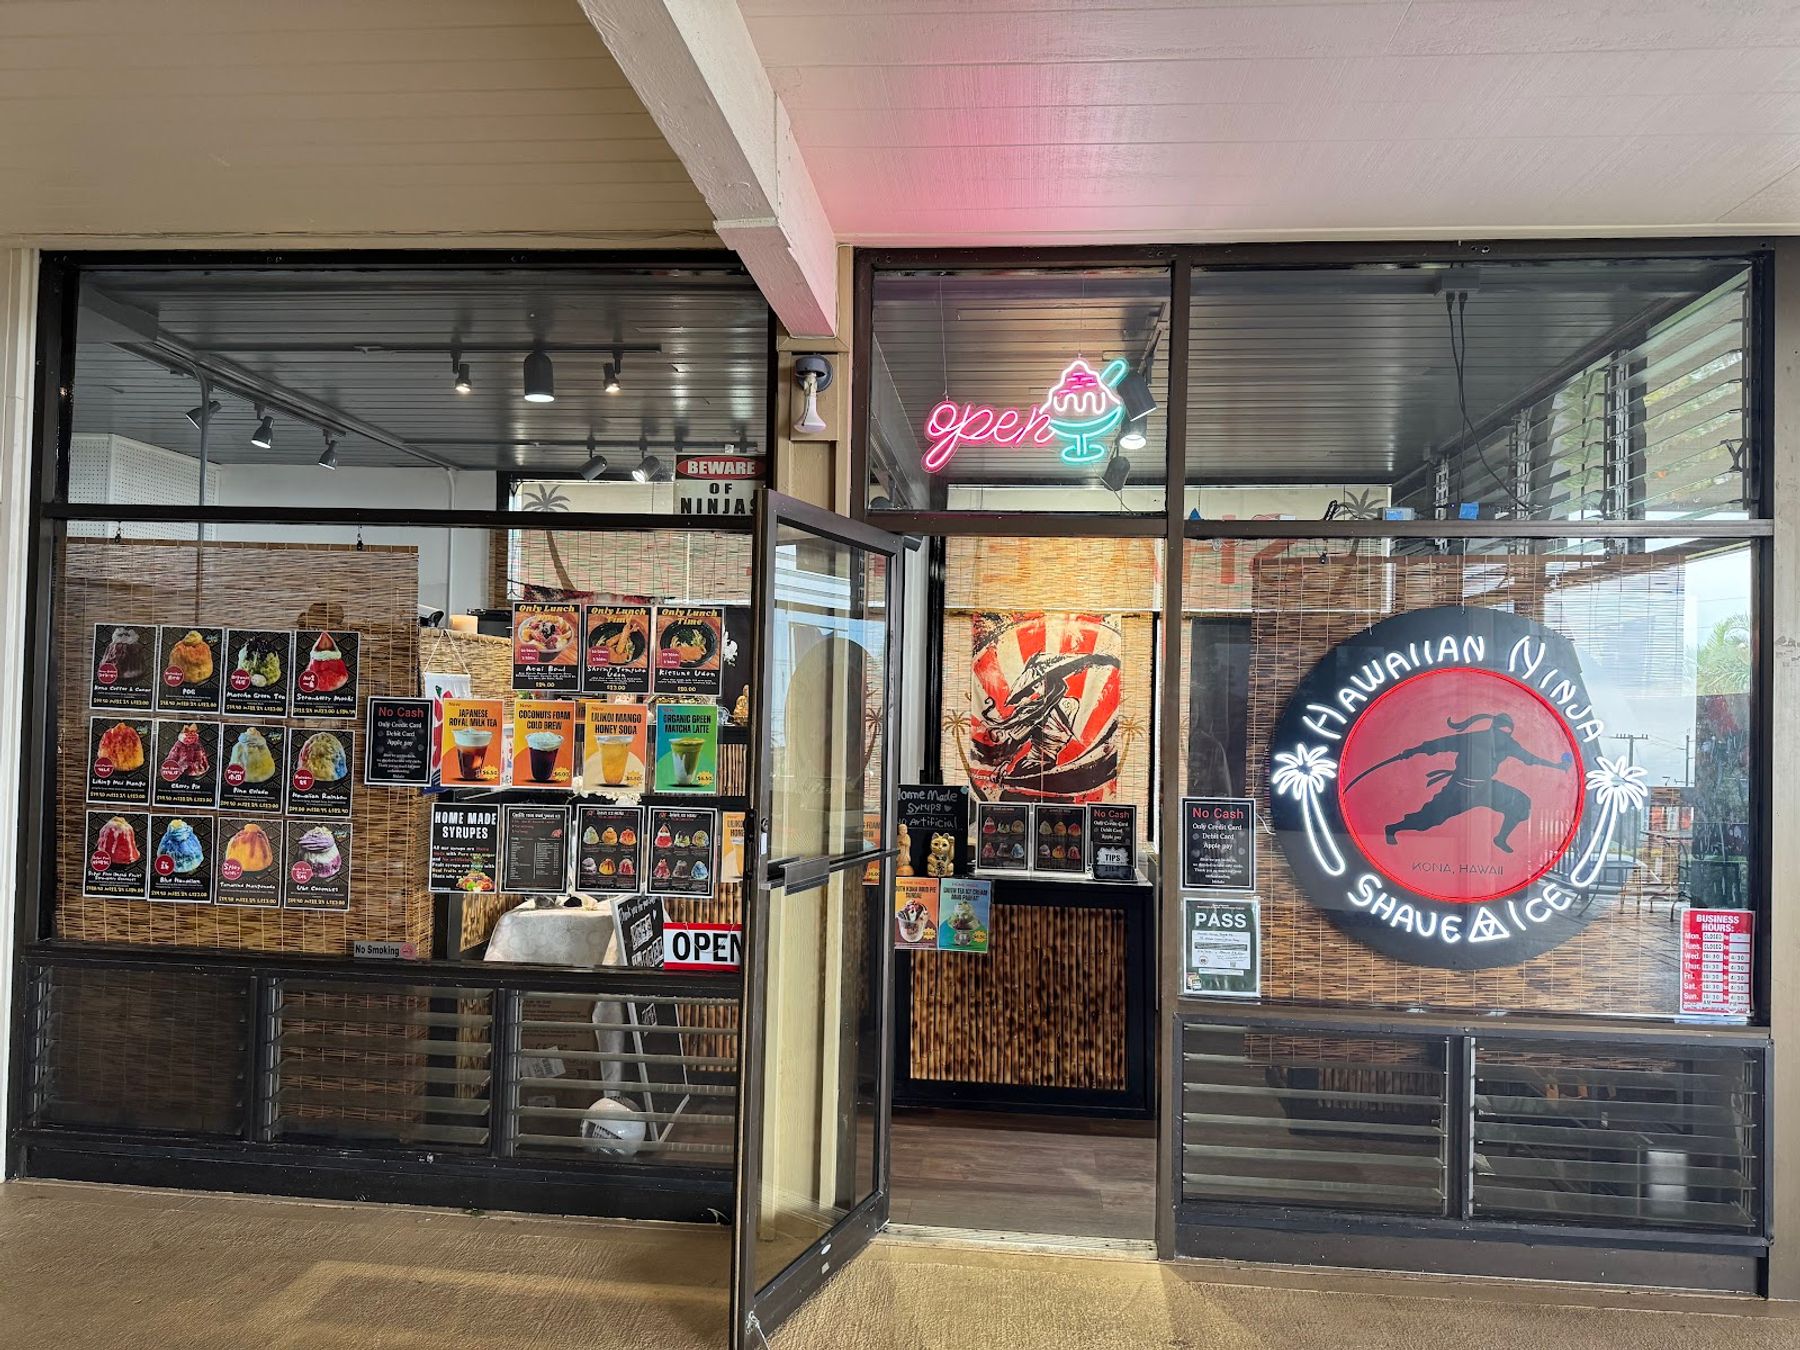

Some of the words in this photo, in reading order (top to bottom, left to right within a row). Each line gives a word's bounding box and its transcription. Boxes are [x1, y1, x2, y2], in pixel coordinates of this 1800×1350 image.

[924, 402, 1056, 468] open
[687, 461, 756, 474] BEWARE
[709, 483, 733, 494] OF
[519, 605, 542, 613] Only
[591, 607, 615, 616] Only
[662, 608, 685, 616] Only
[1302, 634, 1486, 740] HAWAIIAN
[1508, 636, 1606, 744] NINJA
[378, 706, 393, 717] No
[396, 707, 424, 718] Cash
[458, 709, 488, 718] JAPANESE
[518, 710, 552, 720] COCONUTS
[552, 711, 571, 720] FOAM
[449, 717, 469, 726] ROYAL
[469, 718, 485, 727] MILK
[486, 719, 498, 727] TEA
[615, 713, 642, 723] MANGO
[663, 714, 691, 724] ORGANIC
[691, 714, 712, 724] GREEN
[526, 721, 543, 729] COLD
[544, 721, 562, 730] BREW
[595, 724, 618, 734] HONEY
[618, 725, 638, 735] SODA
[664, 725, 691, 733] MATCHA
[692, 725, 710, 733] LATTE
[927, 789, 958, 802] Made
[907, 802, 941, 814] Syrups
[1192, 807, 1210, 818] No
[1213, 808, 1244, 819] Cash
[435, 811, 464, 825] HOME
[467, 812, 497, 825] MADE
[1093, 809, 1106, 818] No
[1108, 810, 1130, 819] Cash
[909, 816, 958, 829] Artificial
[442, 826, 489, 839] SYRUPES
[1203, 842, 1221, 850] Apple
[1105, 854, 1121, 862] TIPS
[1459, 864, 1504, 876] HAWAII
[1347, 873, 1463, 944] SHAVE
[1507, 882, 1573, 932] ICE
[1195, 912, 1247, 928] PASS
[1696, 914, 1740, 924] BUSINESS
[1702, 923, 1735, 932] HOURS:
[1685, 932, 1701, 940] Mon.
[355, 945, 365, 954] No
[367, 945, 400, 957] Smoking
[672, 932, 741, 962] OPEN
[1685, 952, 1701, 960] Wed.
[1684, 992, 1699, 1000] Sun.
